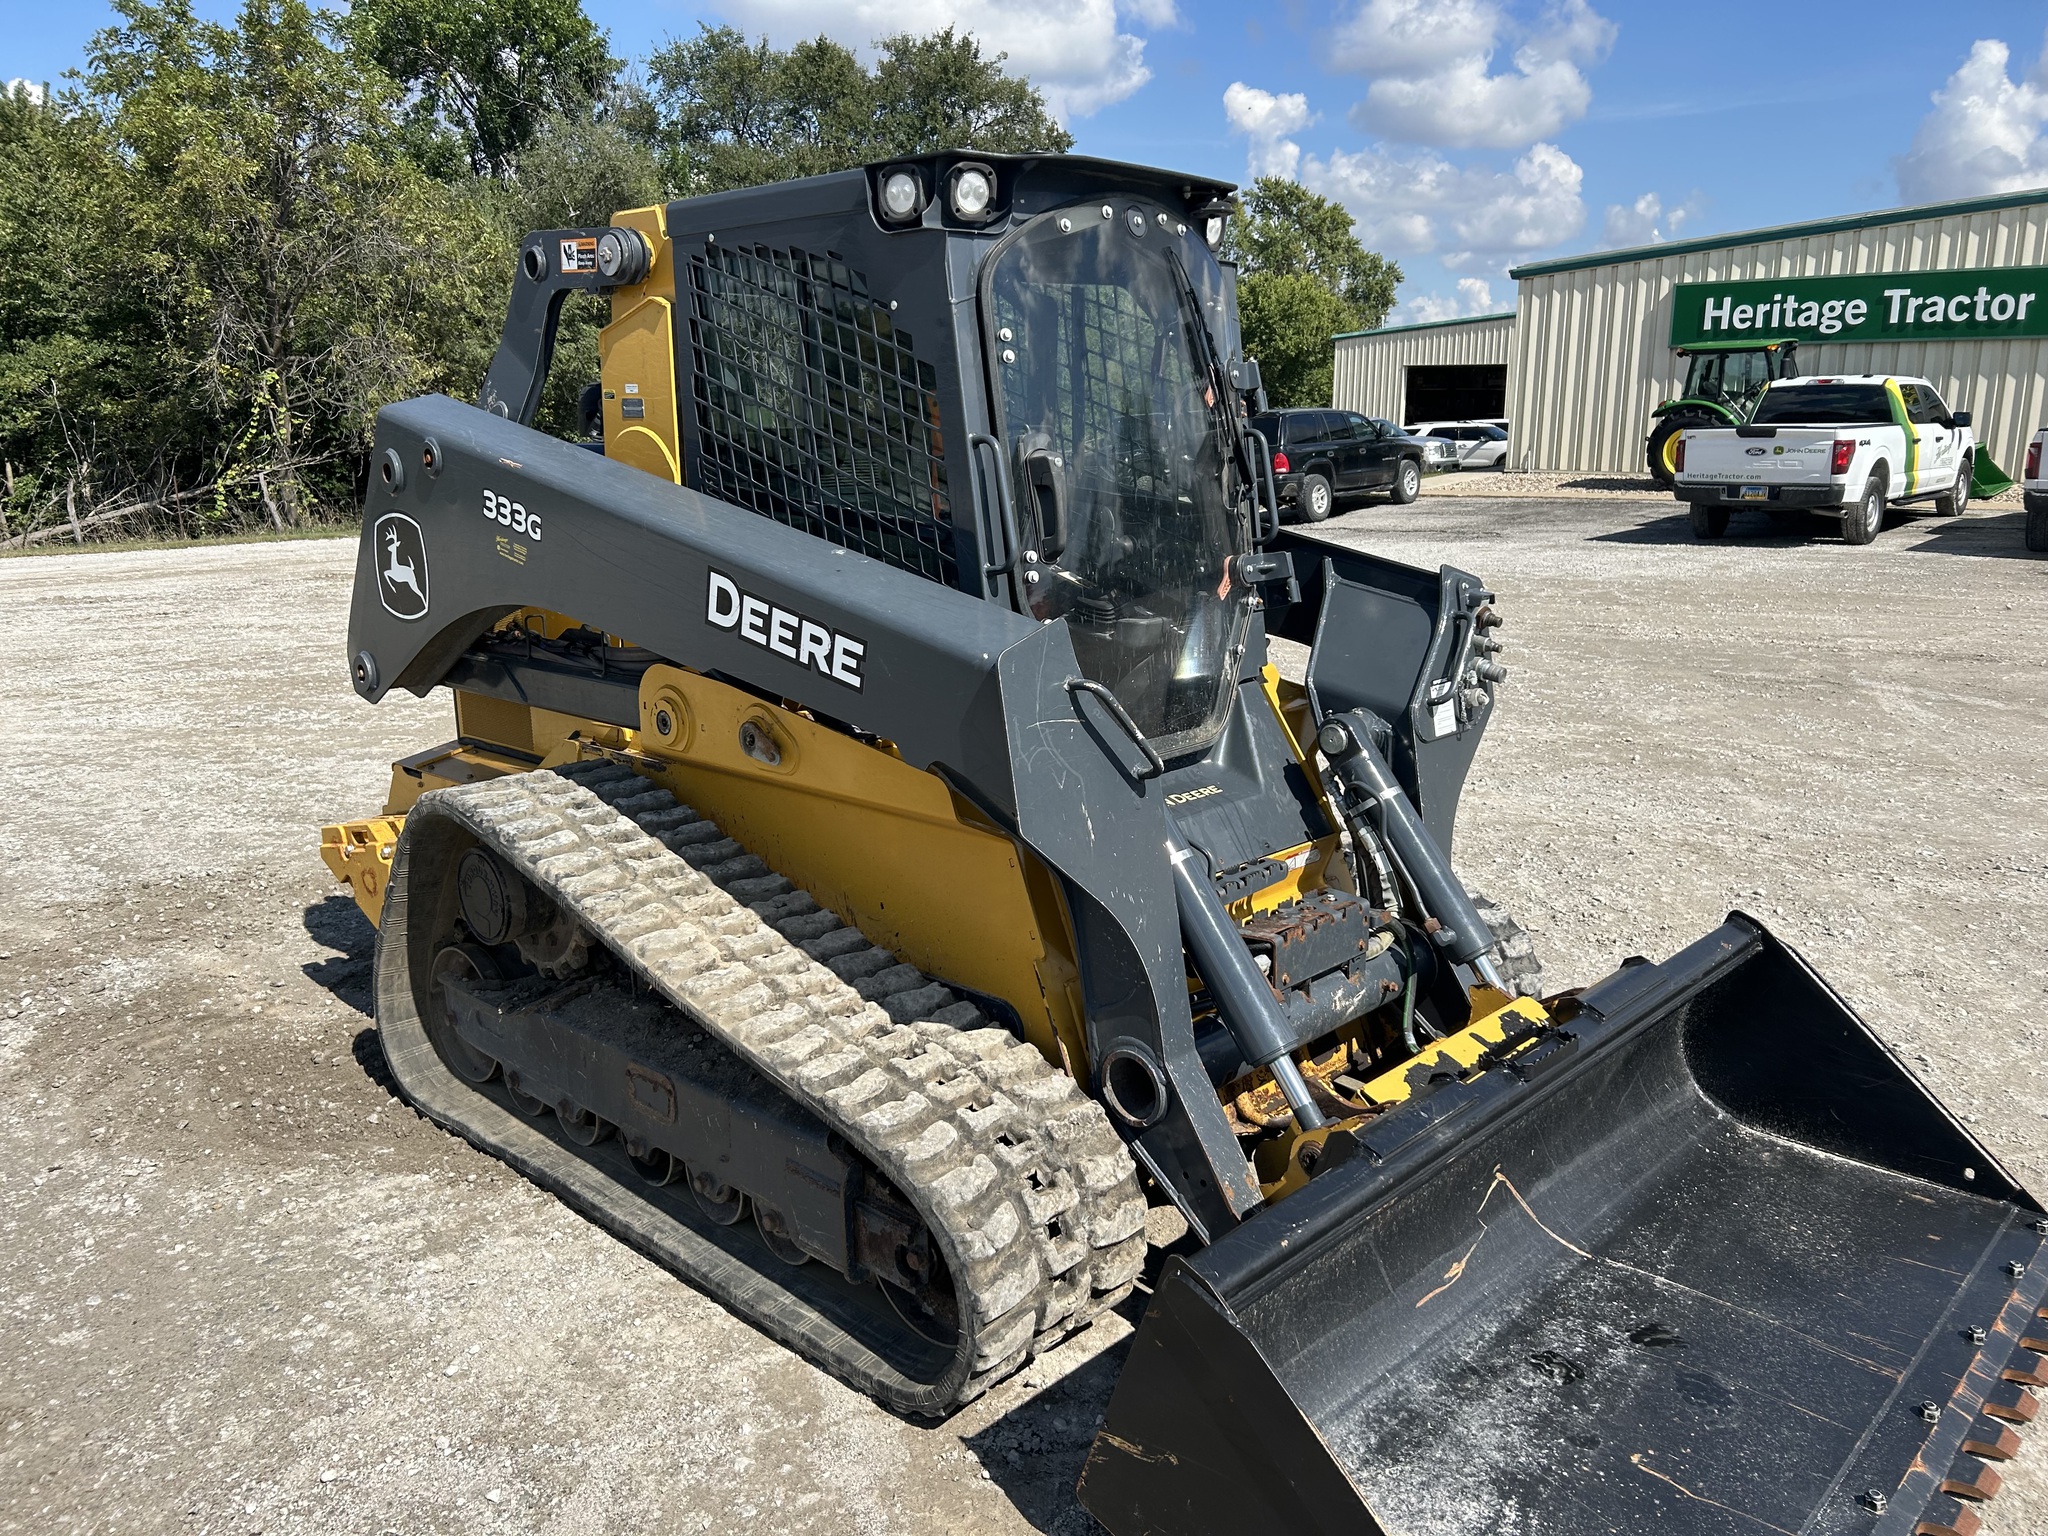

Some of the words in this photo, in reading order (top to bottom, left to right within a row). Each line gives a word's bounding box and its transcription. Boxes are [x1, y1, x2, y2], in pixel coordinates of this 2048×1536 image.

[1703, 294, 1867, 334] Heritage
[1884, 286, 2035, 324] Tractor
[1687, 472, 1762, 480] HeritageTractor.com
[483, 489, 542, 541] 333G
[707, 571, 864, 688] DEERE
[1167, 784, 1224, 804] DEERE
